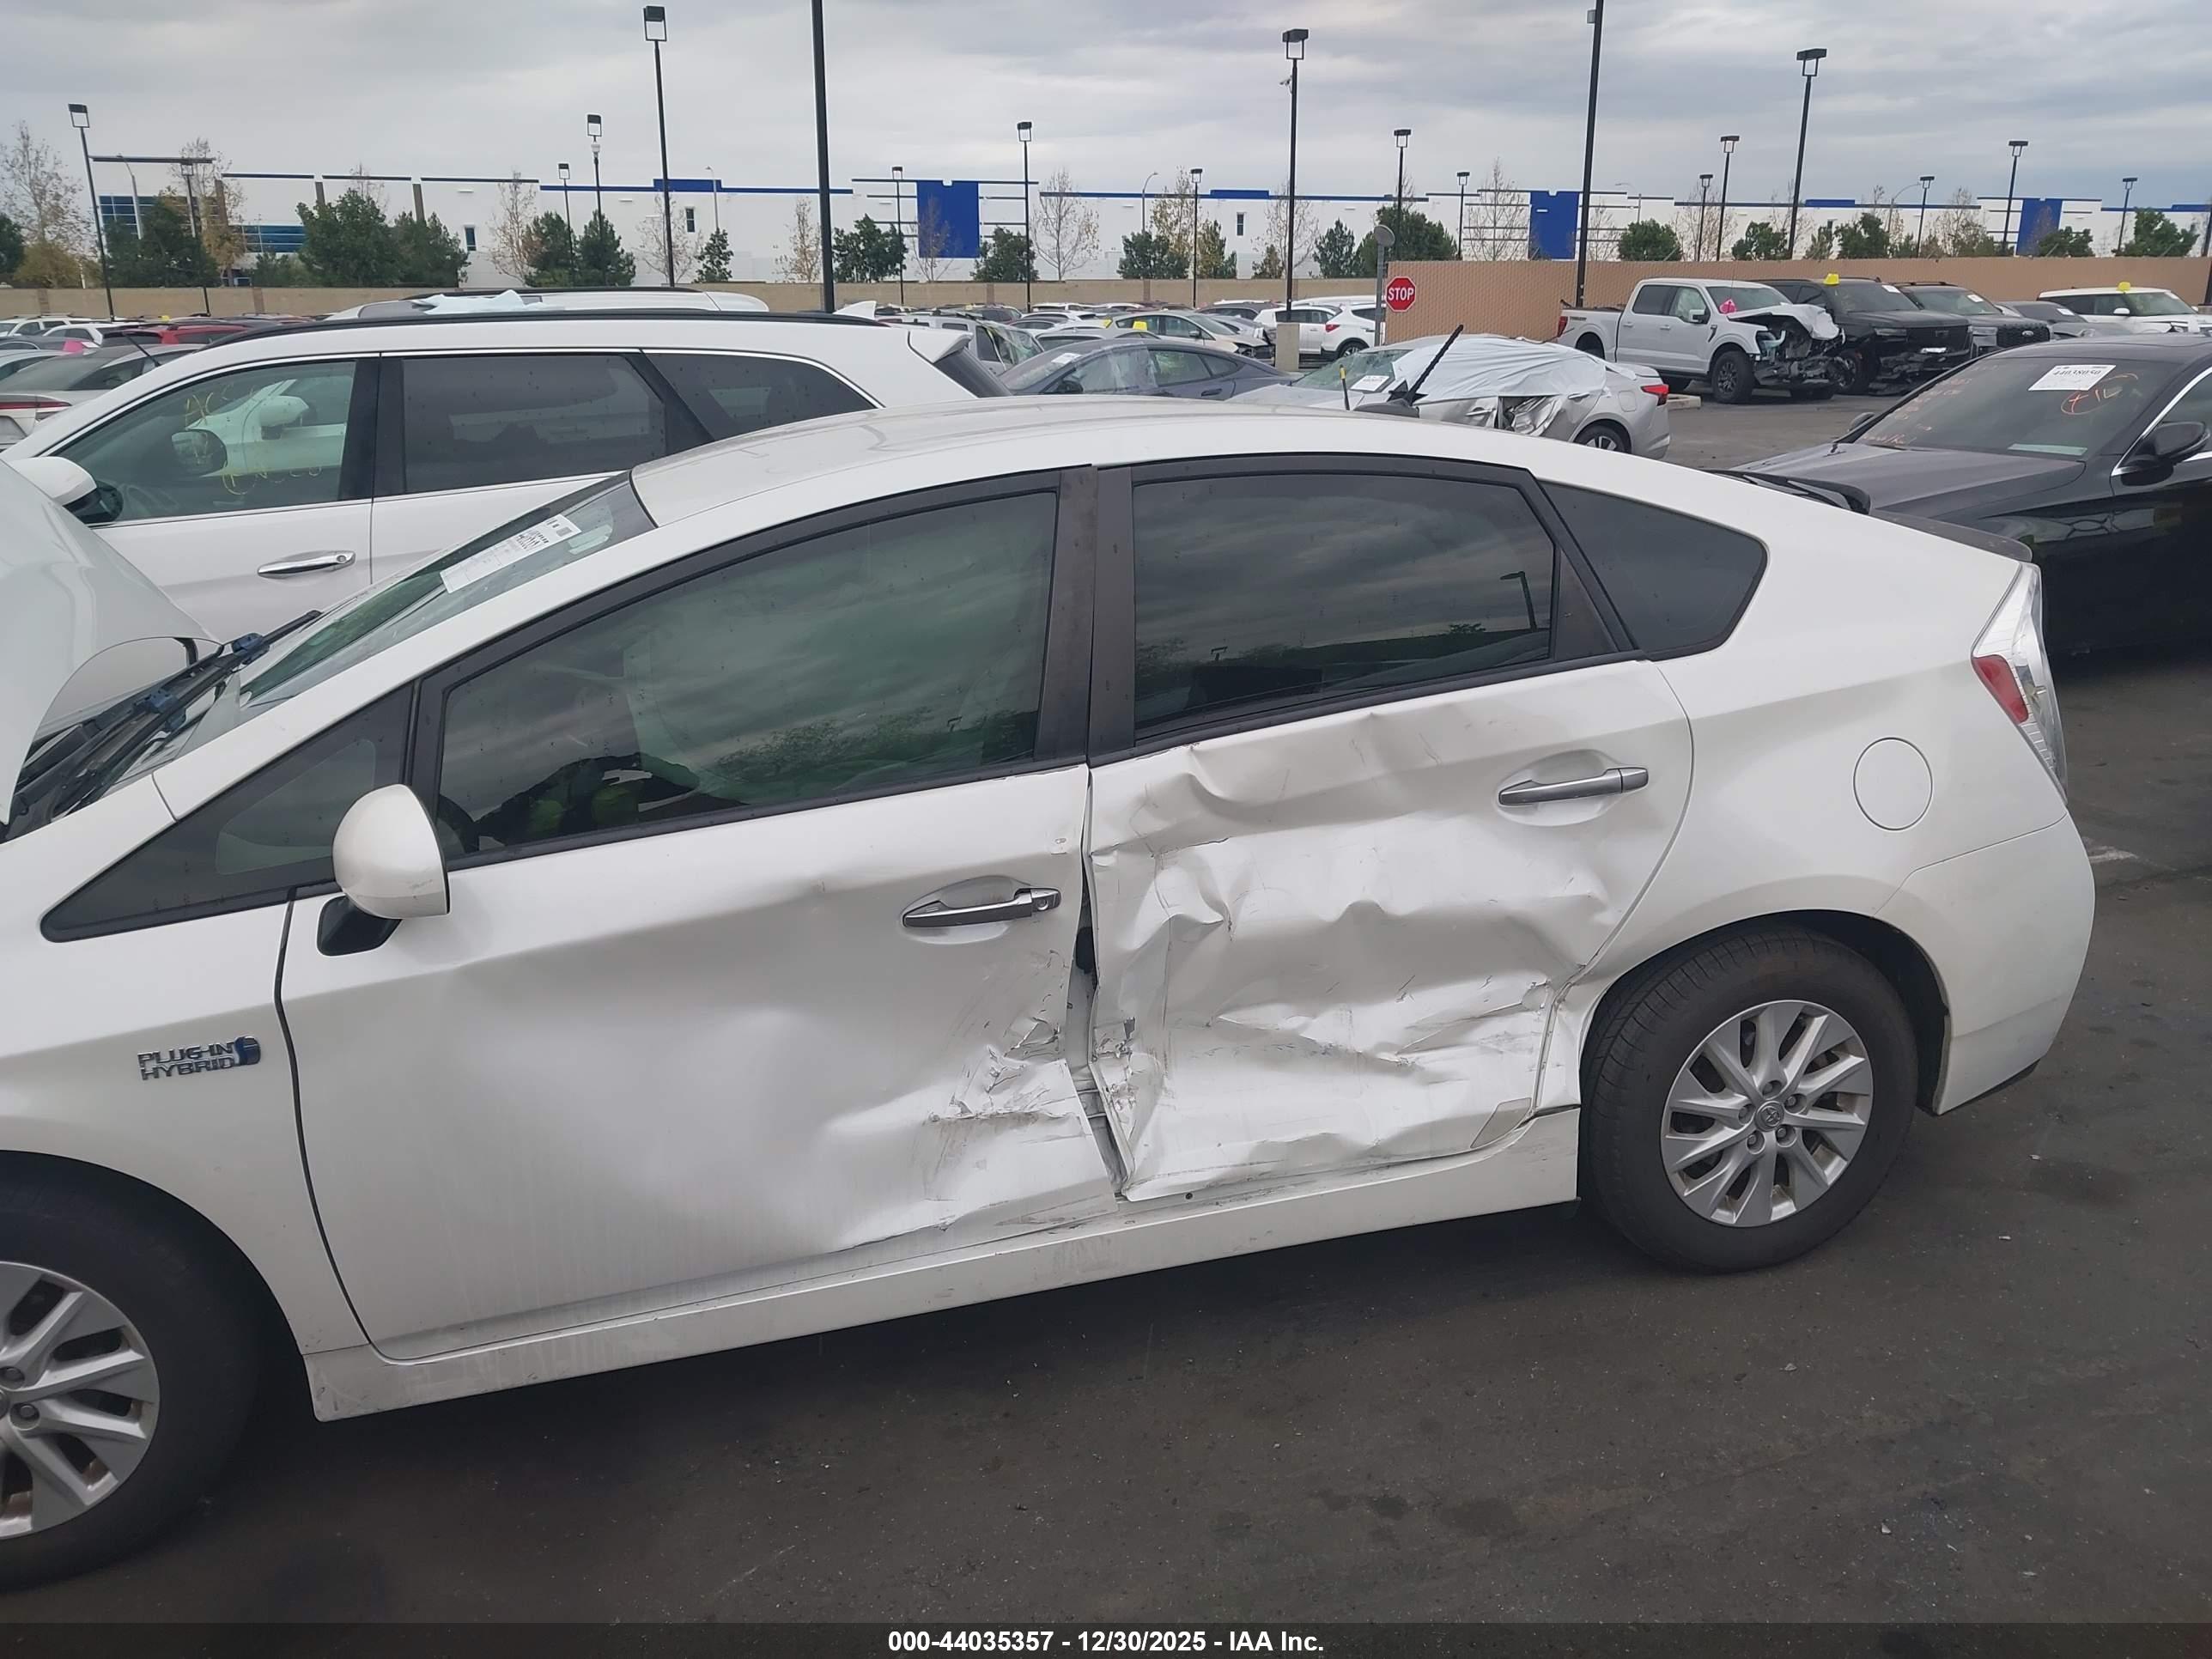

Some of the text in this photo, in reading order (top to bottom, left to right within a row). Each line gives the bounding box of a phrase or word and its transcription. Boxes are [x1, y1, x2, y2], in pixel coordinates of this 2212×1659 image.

[1388, 288, 1414, 301] STOP
[137, 1042, 234, 1066] PLUG-IN
[140, 1056, 234, 1080] HYBRID
